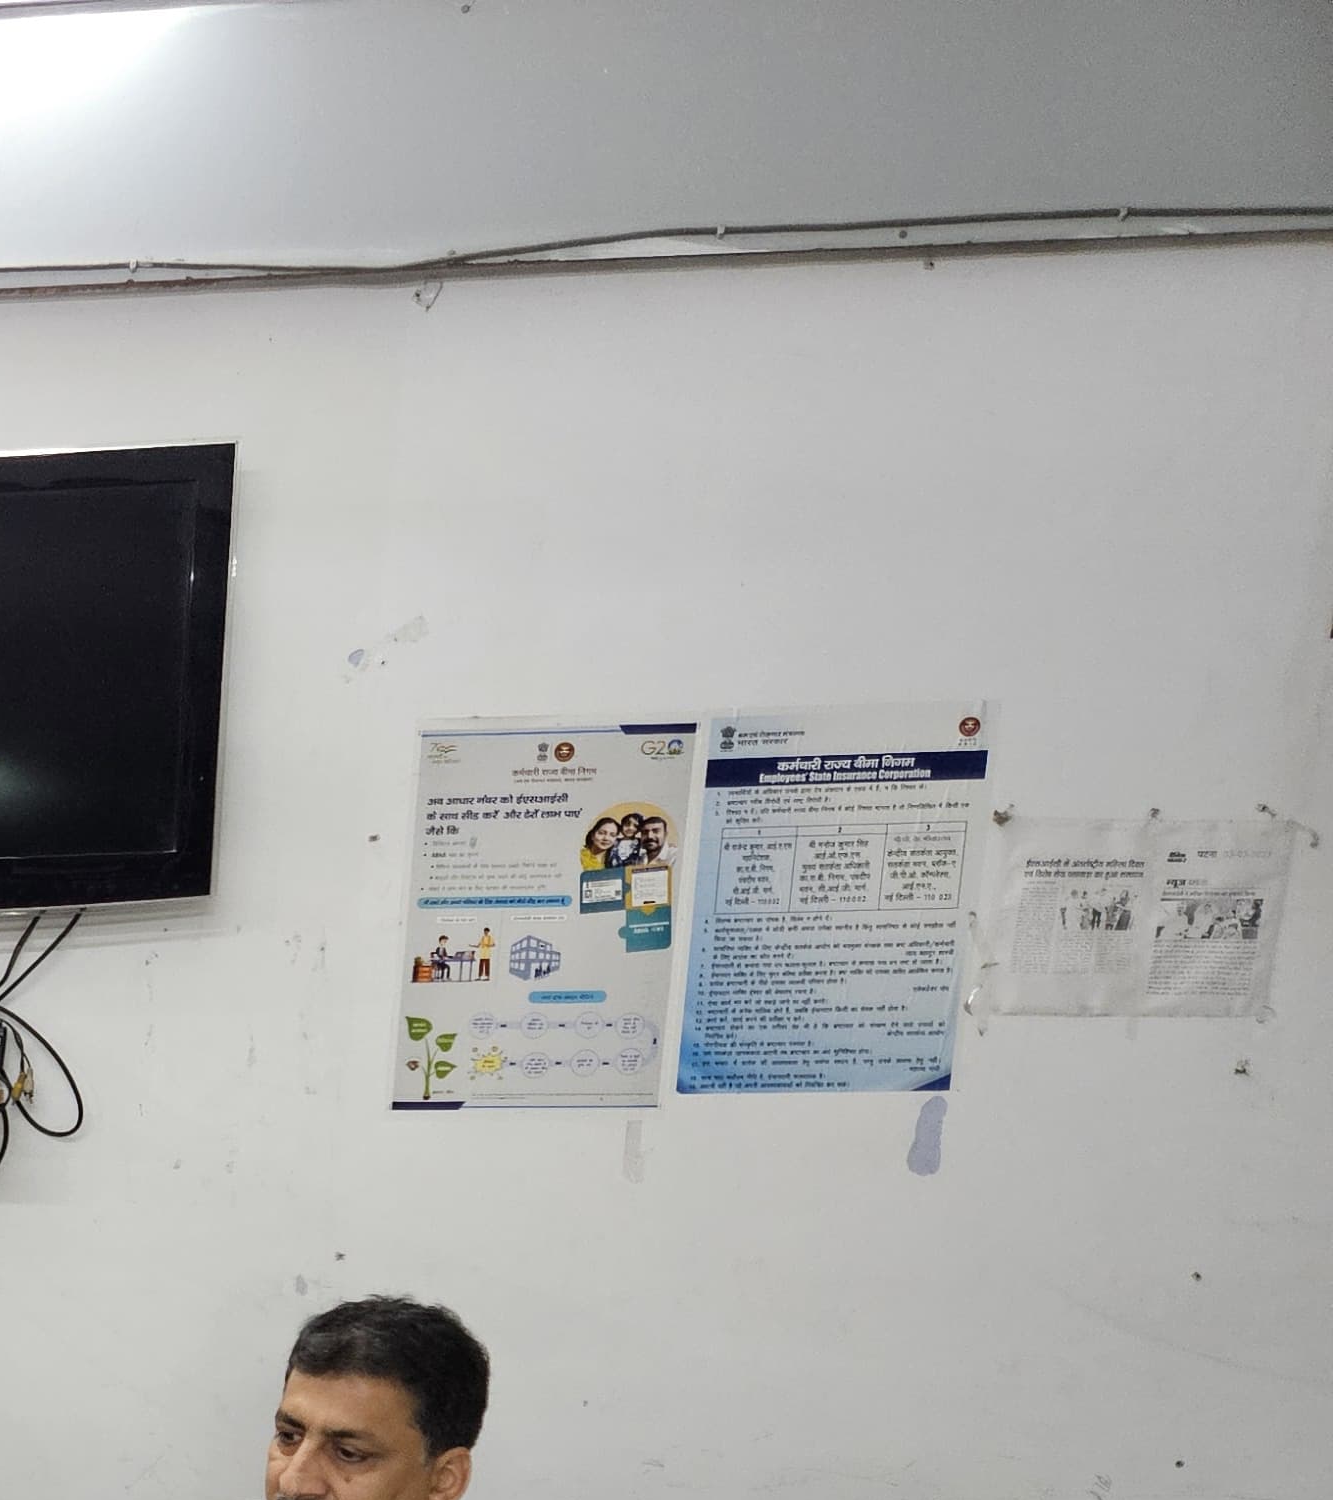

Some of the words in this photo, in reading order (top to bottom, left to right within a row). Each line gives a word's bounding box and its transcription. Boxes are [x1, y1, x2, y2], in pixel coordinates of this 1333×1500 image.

[809, 771, 831, 782] State
[833, 770, 877, 781] Insurance
[879, 768, 931, 780] Corporation
